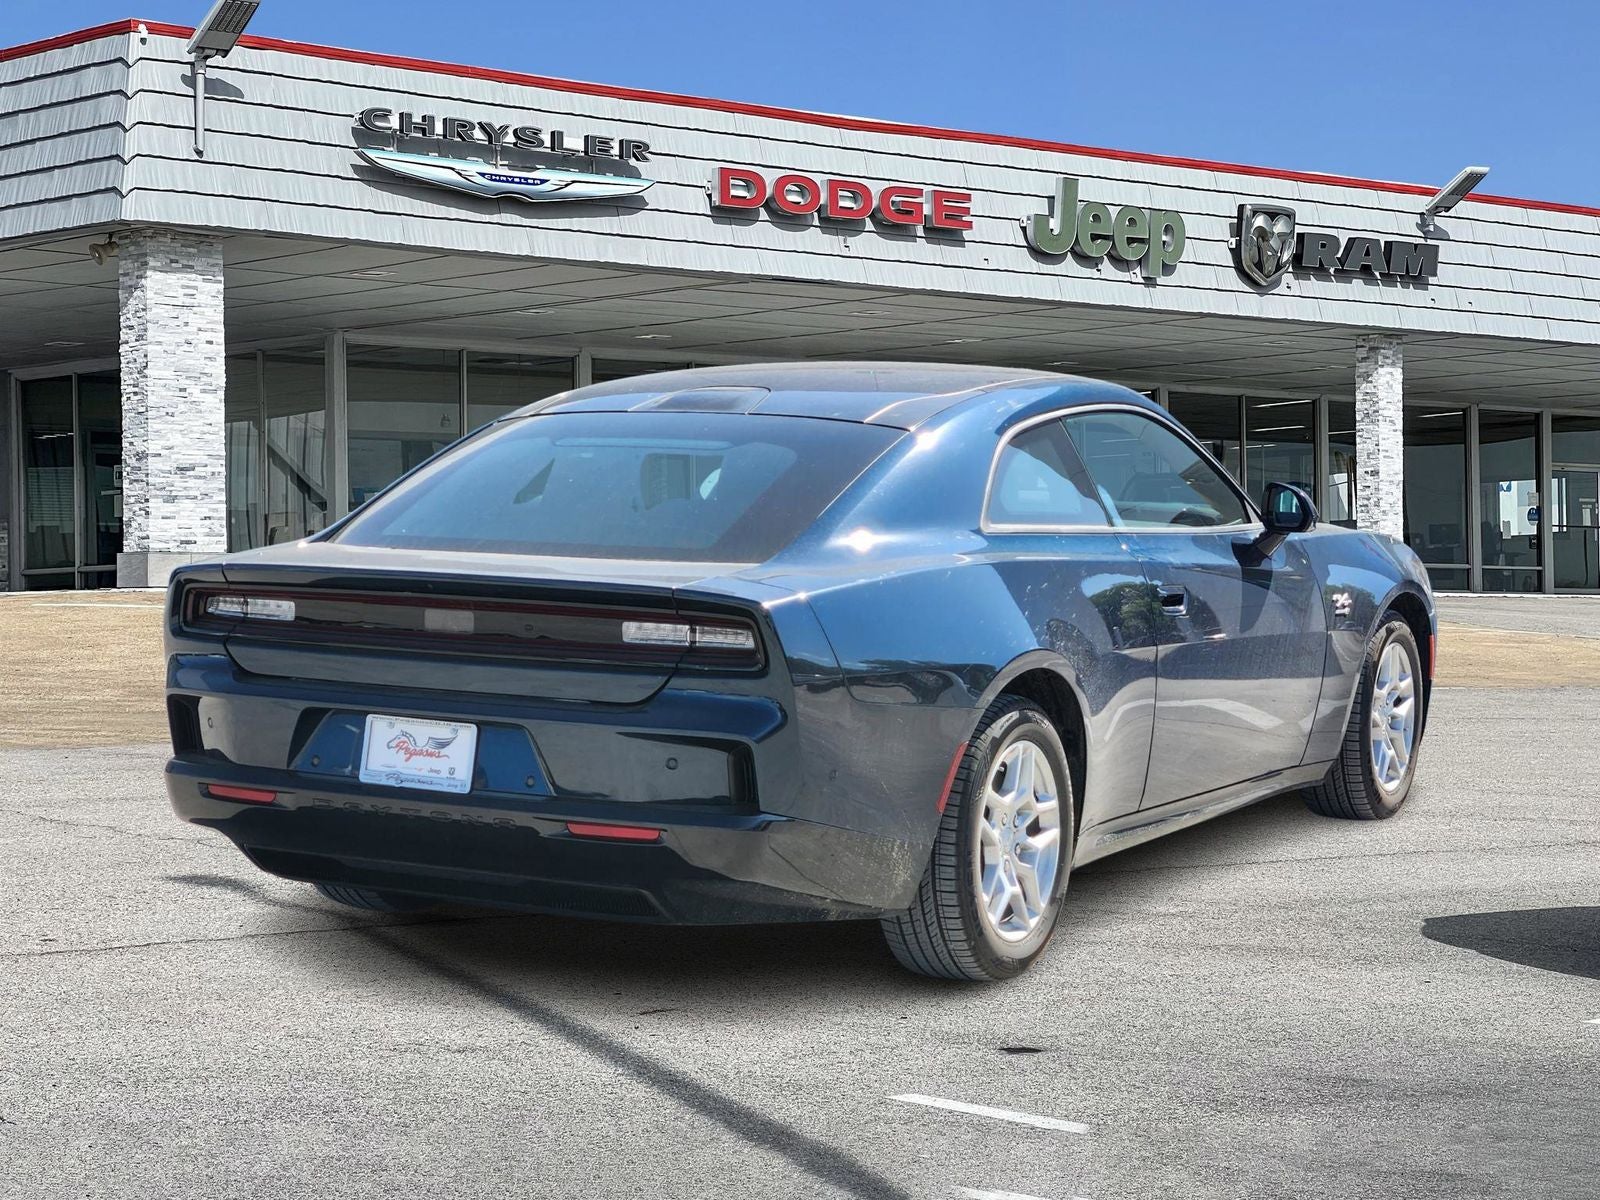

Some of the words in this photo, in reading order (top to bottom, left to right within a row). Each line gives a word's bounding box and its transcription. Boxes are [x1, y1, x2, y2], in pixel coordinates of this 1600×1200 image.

[359, 107, 651, 162] CHRYSLER
[484, 174, 541, 185] CHRYSLER
[712, 167, 974, 231] DODGE
[1027, 177, 1187, 279] Jeep
[1298, 232, 1440, 277] RAM
[394, 740, 450, 762] Pegasus
